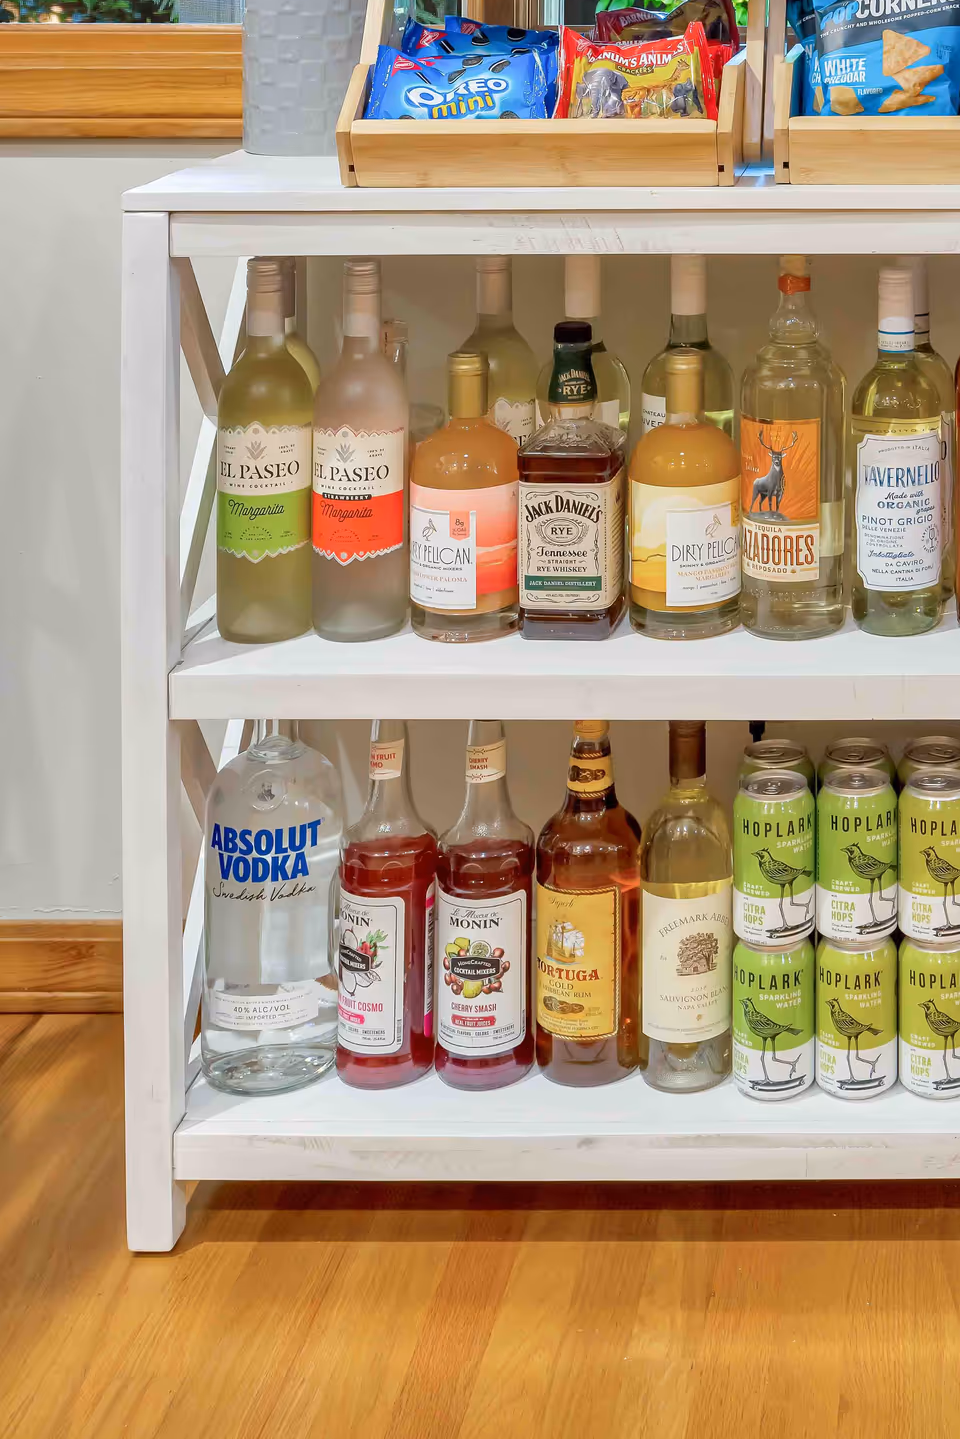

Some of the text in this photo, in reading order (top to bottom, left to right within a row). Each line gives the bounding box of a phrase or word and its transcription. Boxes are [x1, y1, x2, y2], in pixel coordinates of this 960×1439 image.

[820, 3, 960, 39] THE CRUNCHY AND WHOLESOME POPPED-CORN SNACK
[616, 64, 653, 75] CRACKERS
[824, 57, 867, 77] WHITE
[405, 78, 507, 107] OREO
[431, 92, 493, 119] mini
[563, 384, 588, 395] RYE
[912, 444, 930, 452] ITALIA
[220, 459, 300, 480] EL PASEO
[314, 462, 390, 482] EL PASEO
[862, 460, 940, 489] TAVERNELLO
[884, 489, 924, 501] Made with
[228, 499, 285, 521] Margarita
[524, 494, 603, 524] JACK DANIEL'S
[876, 497, 931, 510] ORGANIC
[320, 499, 374, 522] Margarita
[861, 513, 933, 526] PINOT GRIGIO
[550, 526, 574, 536] RYE
[754, 523, 783, 534] TEQUILA
[861, 524, 878, 532] DELLE
[536, 545, 588, 558] Tennessee
[671, 542, 704, 562] DIRTY
[742, 527, 816, 566] AZADORES
[423, 544, 471, 565] PELICAN
[536, 565, 588, 573] RYE WHISKEY
[751, 562, 788, 574] REPOSADO
[895, 558, 924, 568] CAVIRO
[871, 567, 889, 575] NELLA
[376, 752, 397, 761] FRUIT
[742, 814, 812, 838] HOPLARK
[211, 818, 323, 857] ABSOLUT
[217, 851, 310, 884] VODKA
[212, 881, 317, 902] Swedish Vodka
[743, 902, 766, 916] CITRA
[830, 899, 856, 912] CITRA
[911, 901, 933, 914] CITRA
[449, 916, 500, 930] MONIN
[743, 912, 764, 926] HOPS
[830, 910, 854, 923] HOPS
[911, 912, 931, 925] HOPS
[658, 912, 709, 938] FREEMARK
[453, 966, 496, 975] COCKTAIL MIXERS
[536, 956, 600, 982] TORTUGA
[733, 964, 802, 991] HOPLARK
[819, 965, 882, 991] HOPLARK
[548, 979, 574, 991] GOLD
[659, 993, 709, 1003] SAUVIGNON
[758, 989, 802, 1002] SPARKLING
[233, 1003, 291, 1014] 40% ALC/VOL
[357, 1001, 384, 1013] COSMO
[451, 1001, 497, 1013] CHERRY SMASH
[775, 998, 802, 1009] WATER
[910, 1053, 932, 1067] CITRA
[910, 1064, 930, 1078] HOPS
